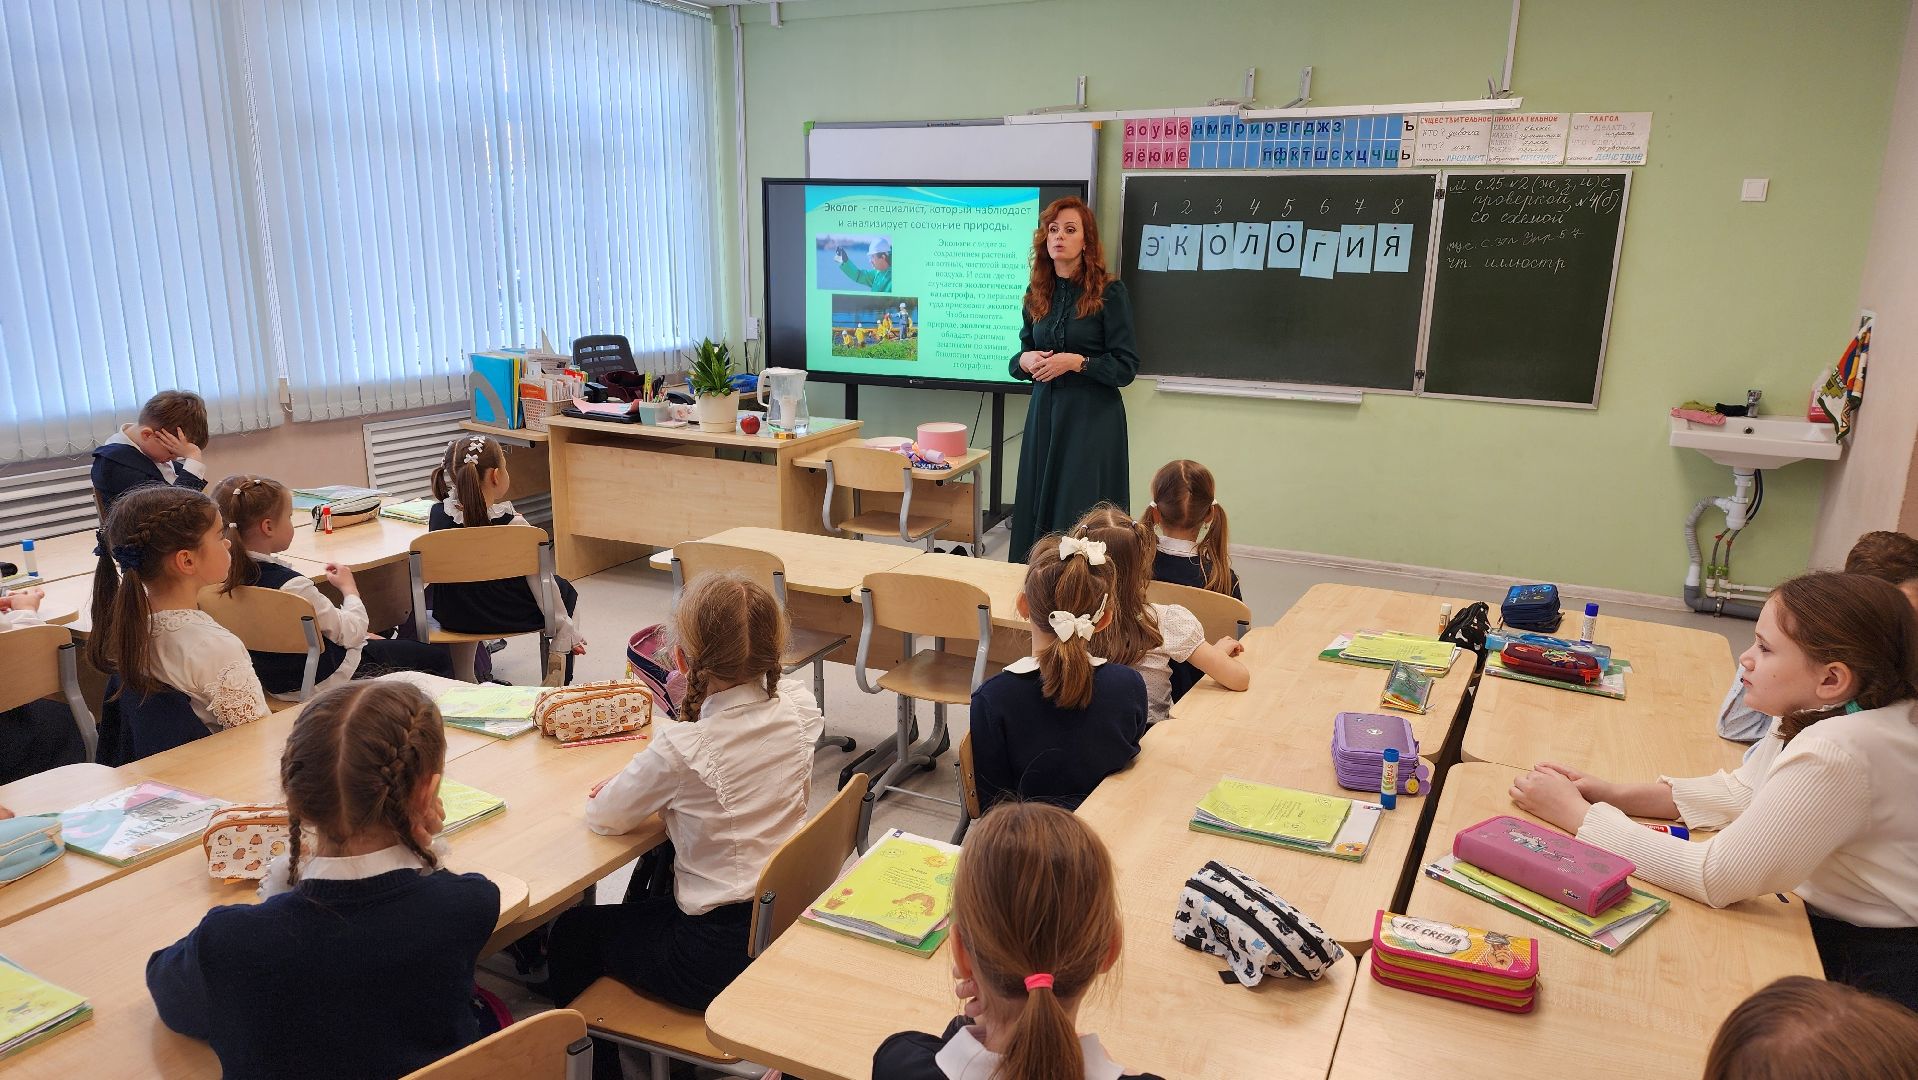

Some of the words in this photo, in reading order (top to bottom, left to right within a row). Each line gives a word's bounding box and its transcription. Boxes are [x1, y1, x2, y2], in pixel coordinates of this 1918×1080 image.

[824, 202, 858, 212] Эколог
[868, 204, 928, 216] специалист,
[930, 203, 972, 216] который
[975, 205, 1032, 216] наблюдает
[1150, 201, 1158, 216] 1
[1180, 199, 1193, 216] 2
[1212, 198, 1224, 215] 3
[1250, 198, 1262, 216] 4
[1281, 198, 1296, 218] 5
[1319, 198, 1330, 215] 6
[1354, 199, 1367, 216] 7
[1391, 198, 1404, 215] 8
[838, 220, 844, 228] и
[846, 220, 908, 231] анализирует
[910, 222, 961, 230] состояние
[963, 222, 1013, 232] природы.
[938, 238, 972, 248] Экологи
[1401, 922, 1420, 932] ICE
[1422, 928, 1462, 946] CREAM
